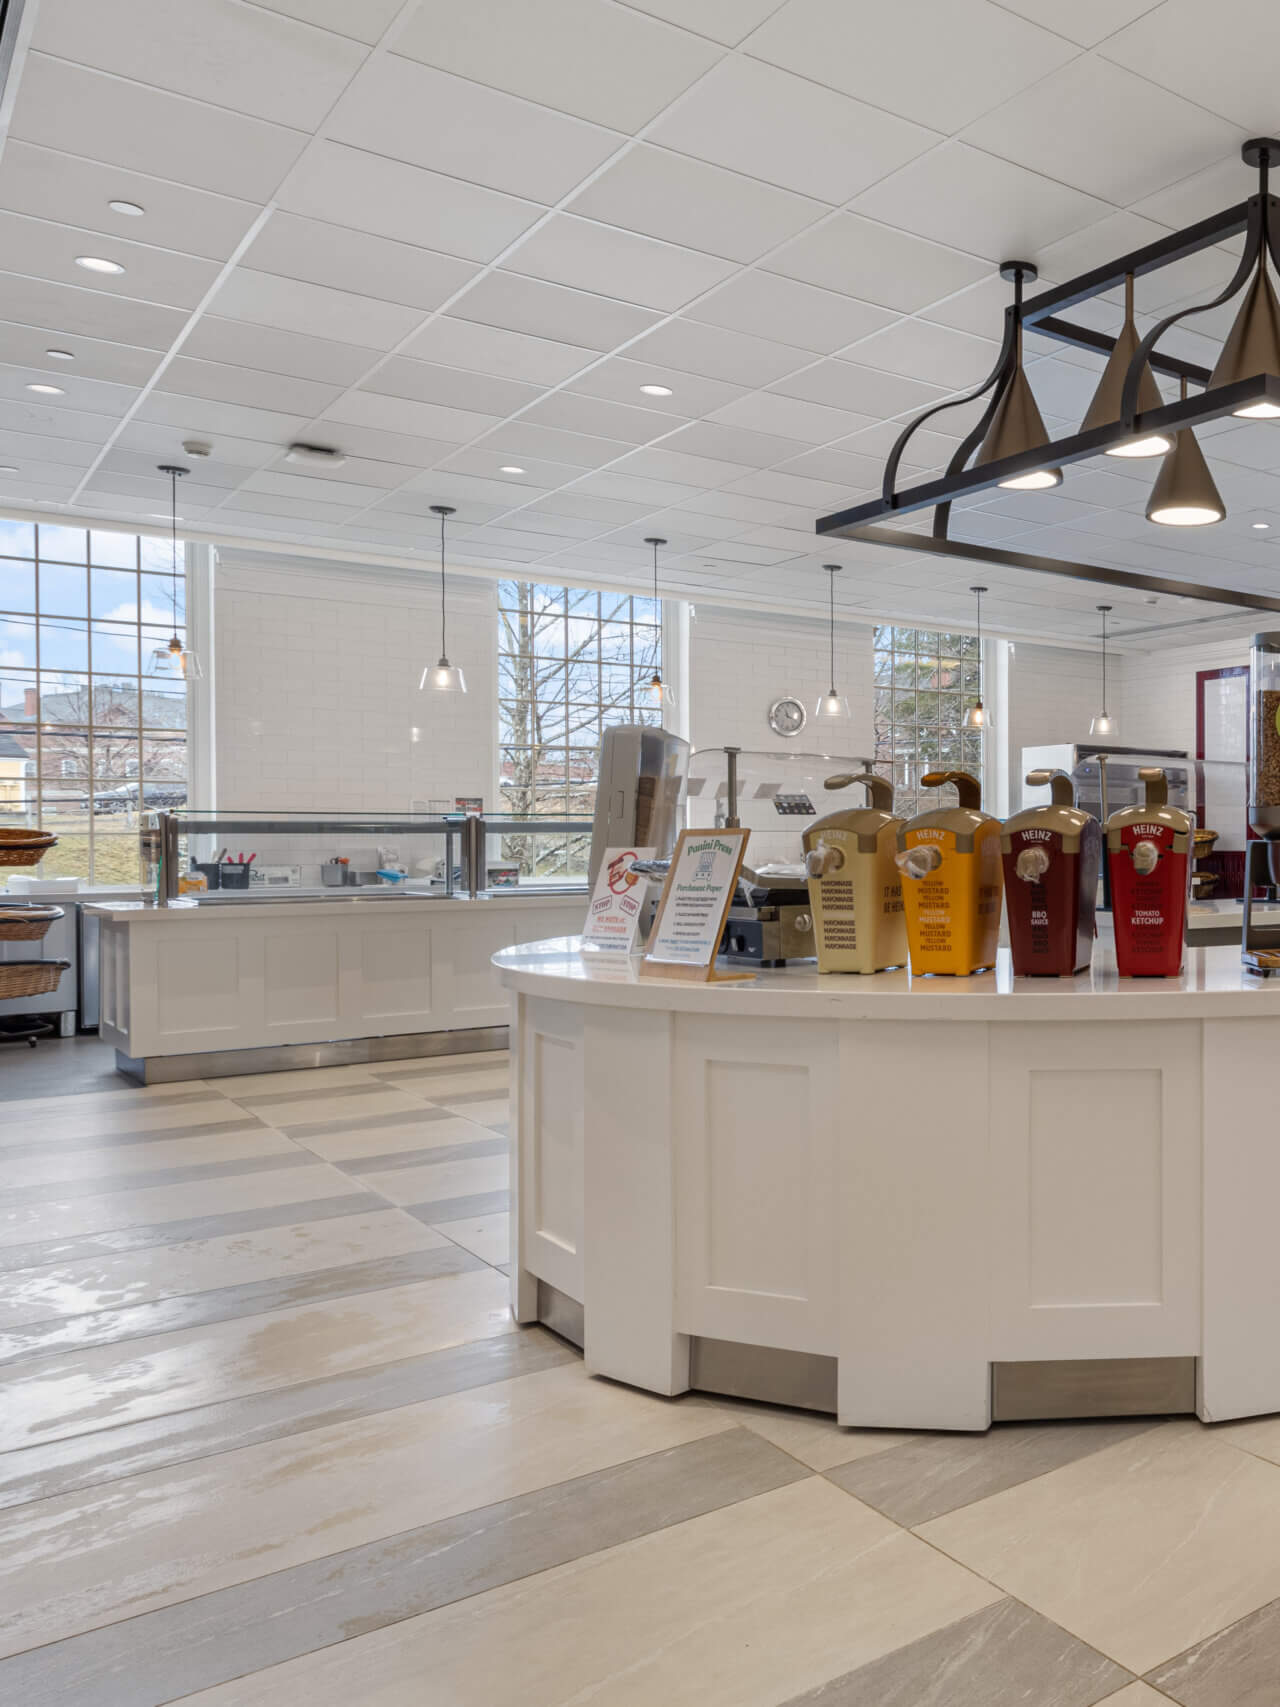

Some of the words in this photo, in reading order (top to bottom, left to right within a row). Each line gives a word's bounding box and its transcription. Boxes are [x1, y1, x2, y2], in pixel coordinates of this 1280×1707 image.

[916, 828, 945, 840] HEINZ
[1021, 829, 1052, 841] HEINZ
[1132, 824, 1164, 836] HEINZ
[687, 839, 713, 856] Panini
[713, 839, 733, 856] Press
[1032, 911, 1047, 919] BBQ
[1131, 917, 1164, 925] KETCHUP
